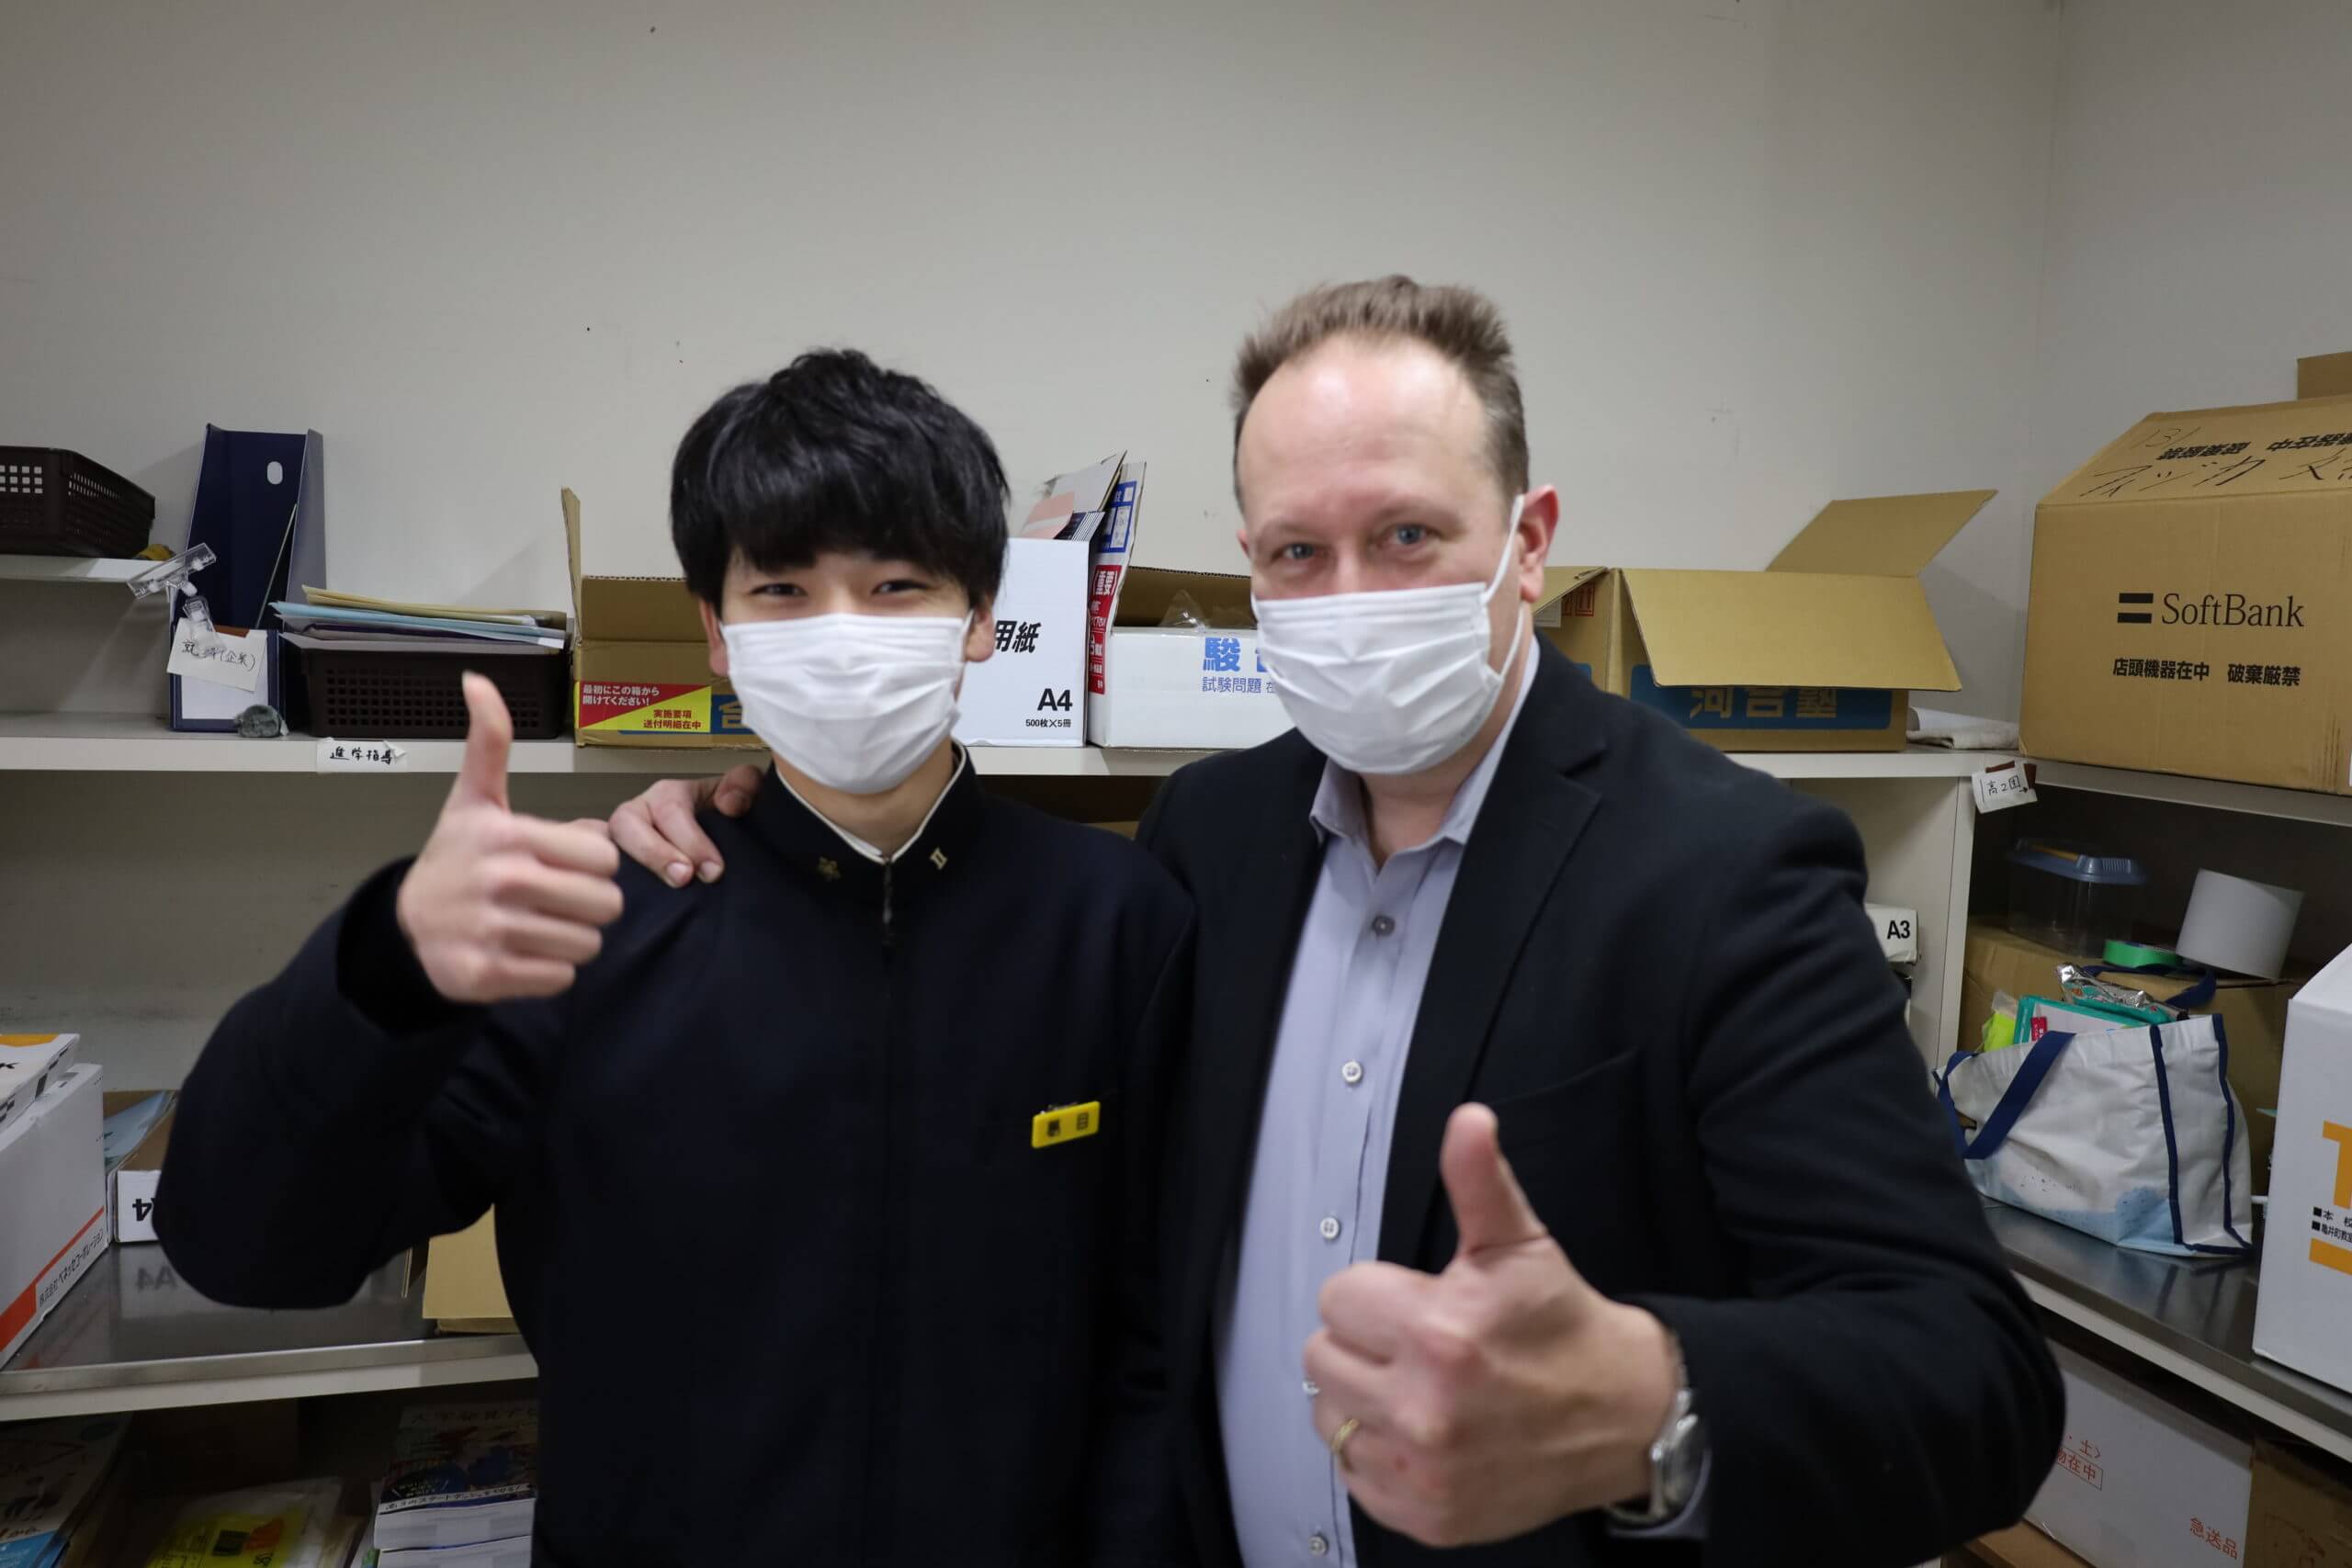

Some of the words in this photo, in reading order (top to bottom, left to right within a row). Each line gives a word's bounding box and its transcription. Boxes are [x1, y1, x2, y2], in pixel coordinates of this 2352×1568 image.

[2162, 592, 2305, 627] SoftBank
[2113, 658, 2210, 681] 店頭機器在中
[2227, 663, 2301, 686] 破棄厳禁
[582, 683, 660, 696] 最初にこの箱から
[1202, 676, 1262, 694] 試験問題
[1037, 688, 1073, 711] A4
[653, 709, 693, 719] 実施要項
[643, 719, 702, 730] 送付明細在中
[1886, 919, 1912, 940] A3
